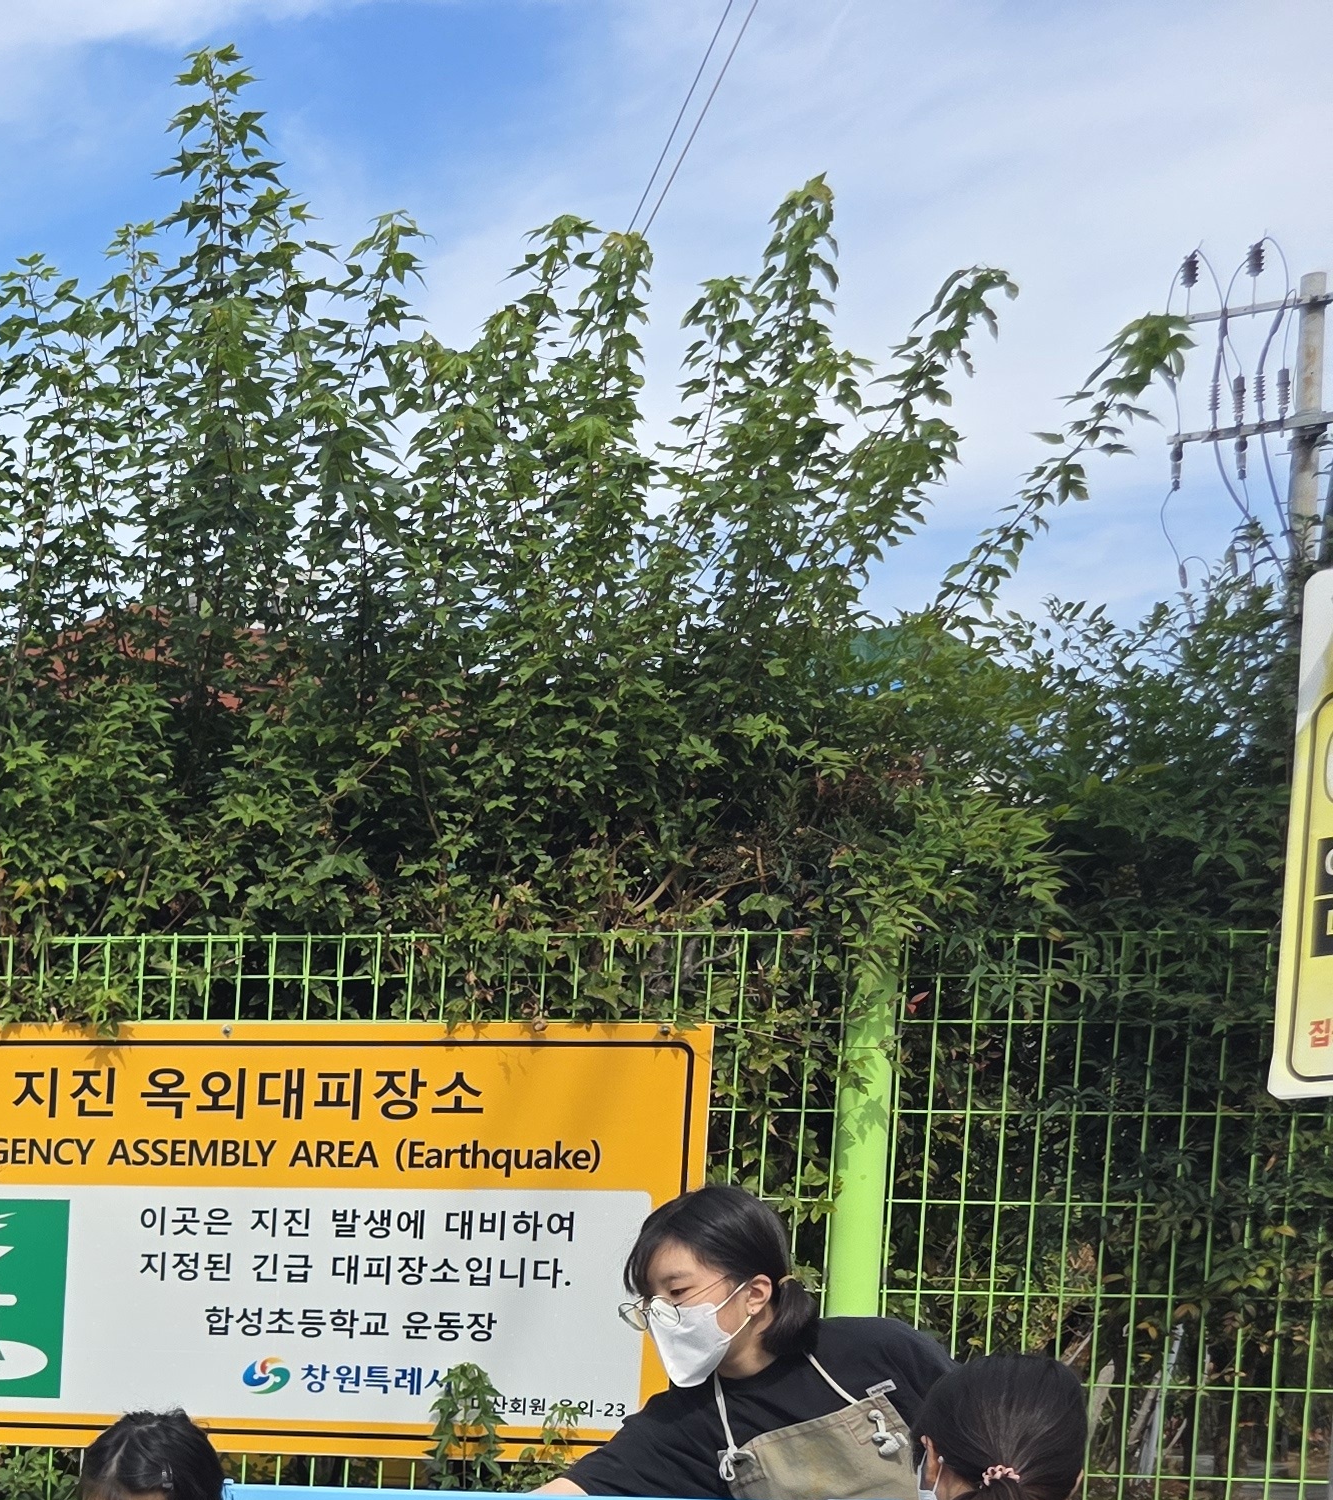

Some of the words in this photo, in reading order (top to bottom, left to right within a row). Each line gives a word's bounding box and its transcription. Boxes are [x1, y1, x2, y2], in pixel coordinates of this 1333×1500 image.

[1308, 1019, 1333, 1047] 집
[11, 1066, 117, 1119] 지진
[139, 1066, 484, 1120] 옥외대피장소
[106, 1138, 278, 1168] ASSEMBLY
[288, 1139, 380, 1169] AREA
[395, 1137, 601, 1178] (Earthquake)
[140, 1205, 233, 1237] 이곳은
[250, 1207, 311, 1238] 지진
[331, 1208, 426, 1240] 발생에
[444, 1209, 575, 1242] 대비하여
[139, 1251, 232, 1282] 지정된
[252, 1252, 314, 1284] 긴급
[331, 1253, 572, 1289] 대피장소입니다.
[204, 1305, 390, 1340] 합성초등학교
[401, 1310, 498, 1343] 운동장
